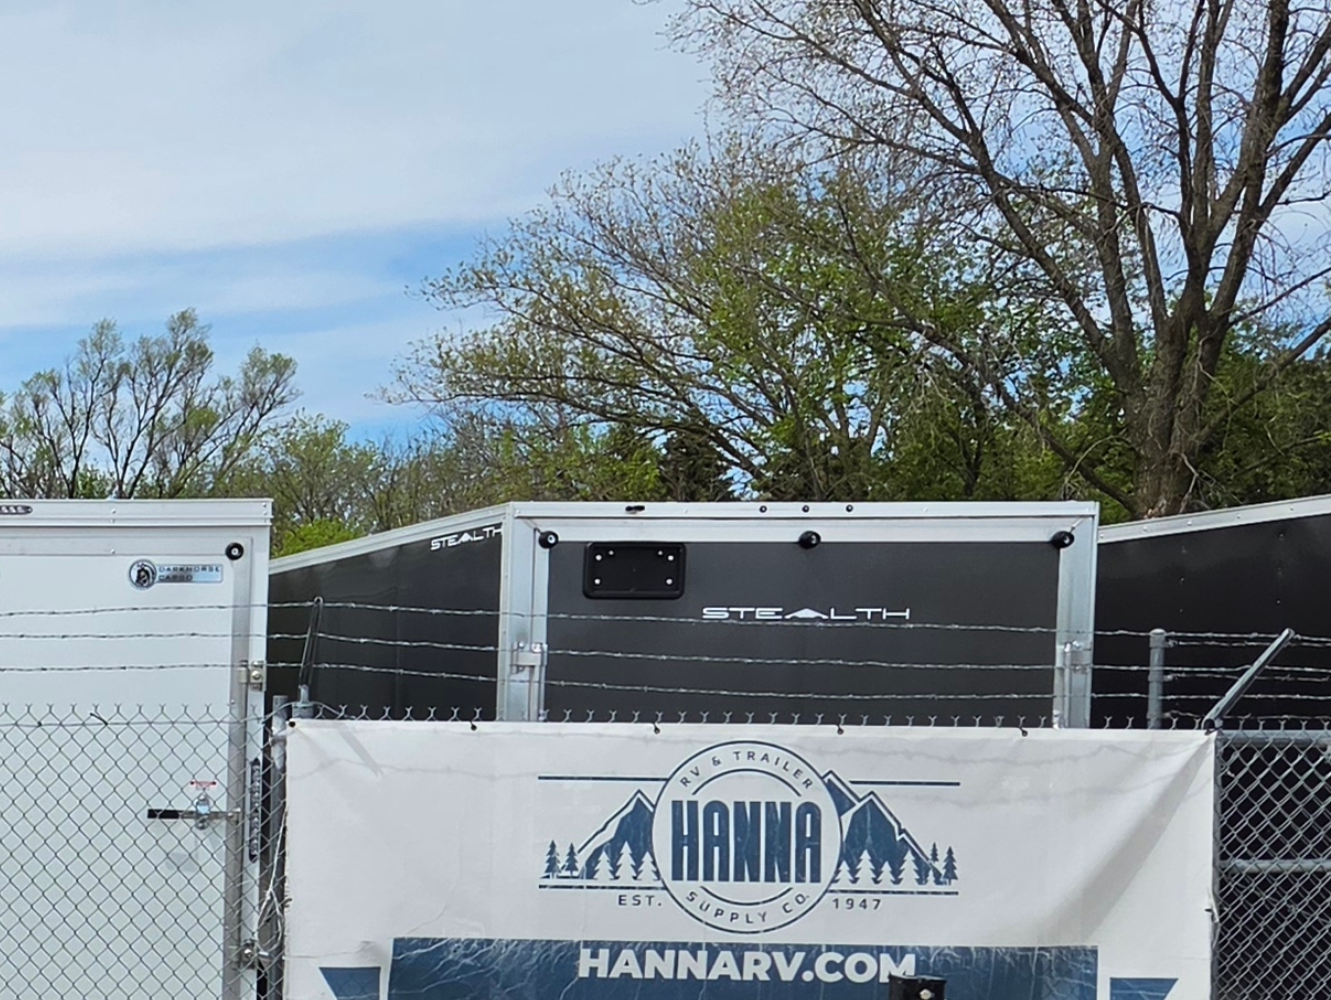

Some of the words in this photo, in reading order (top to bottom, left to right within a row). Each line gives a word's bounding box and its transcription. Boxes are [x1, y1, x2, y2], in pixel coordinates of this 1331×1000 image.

[431, 526, 503, 550] STEALTH
[702, 607, 910, 620] STEALTH
[679, 766, 701, 787] RV
[712, 756, 722, 767] &
[733, 751, 815, 789] TRAILER
[671, 800, 822, 883] HANNA
[618, 894, 662, 907] EST.
[832, 898, 882, 910] 1947
[686, 891, 768, 924] SUPPLY
[782, 893, 810, 914] CO.
[578, 949, 916, 984] HANNARV.COM
